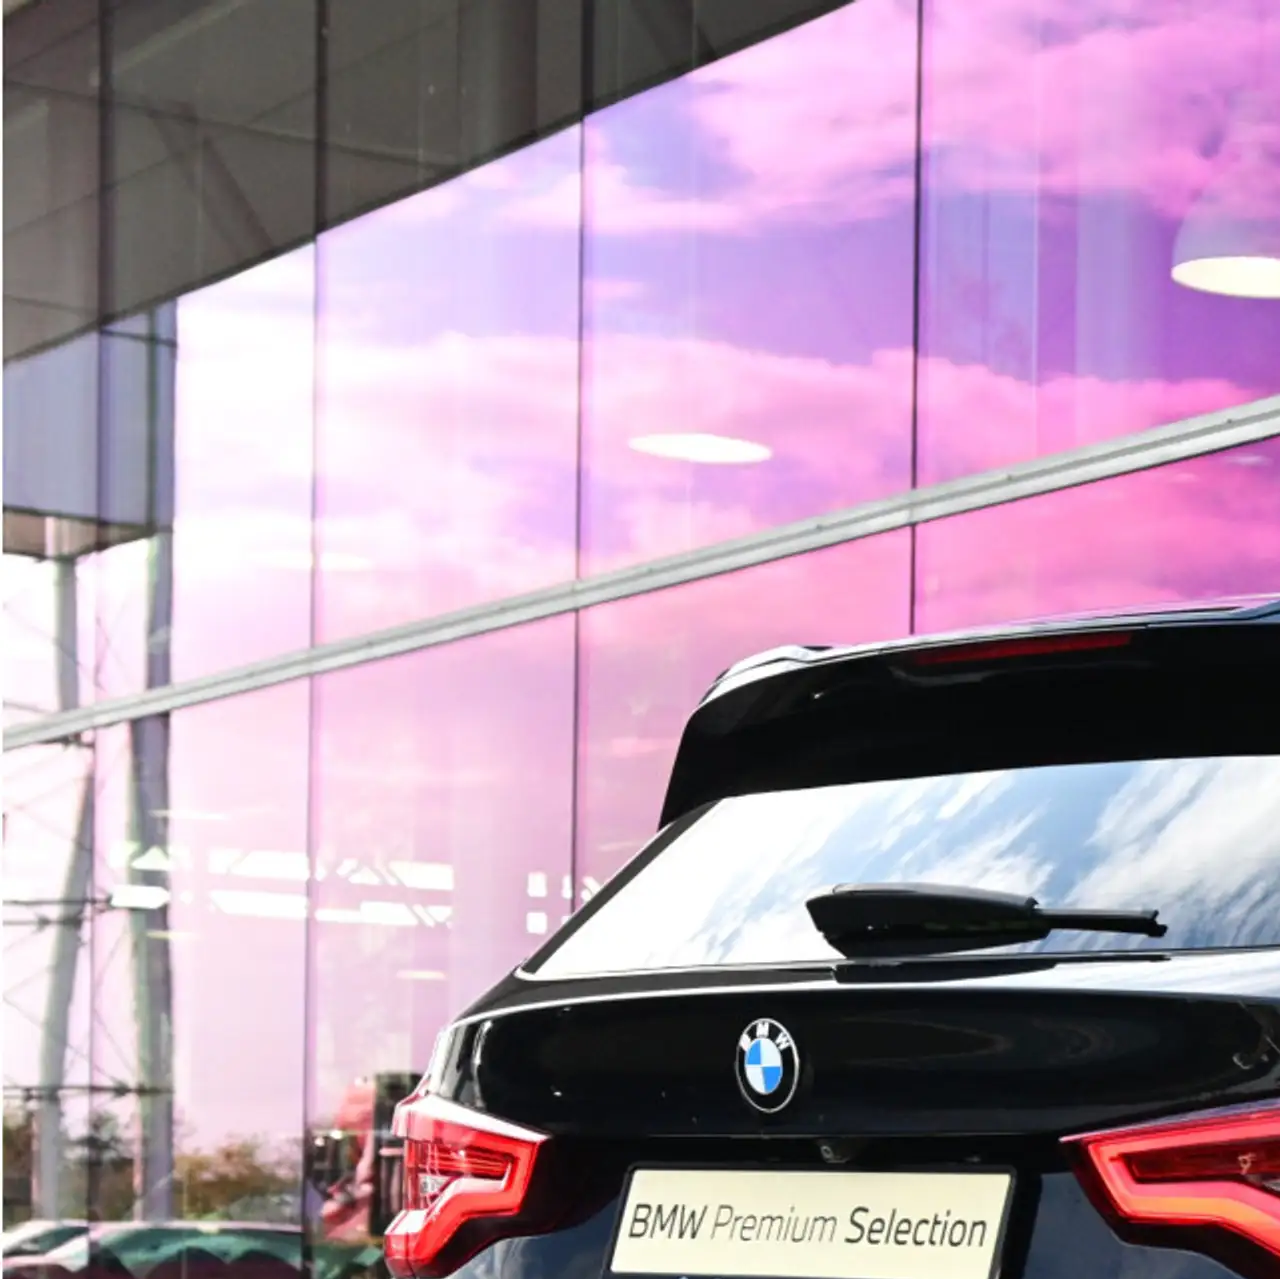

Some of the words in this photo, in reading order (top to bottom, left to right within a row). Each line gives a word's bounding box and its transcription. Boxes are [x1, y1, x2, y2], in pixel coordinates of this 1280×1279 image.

[740, 1021, 792, 1052] BMW
[628, 1203, 708, 1240] BMW
[709, 1203, 838, 1244] Premium
[844, 1206, 988, 1248] Selection
